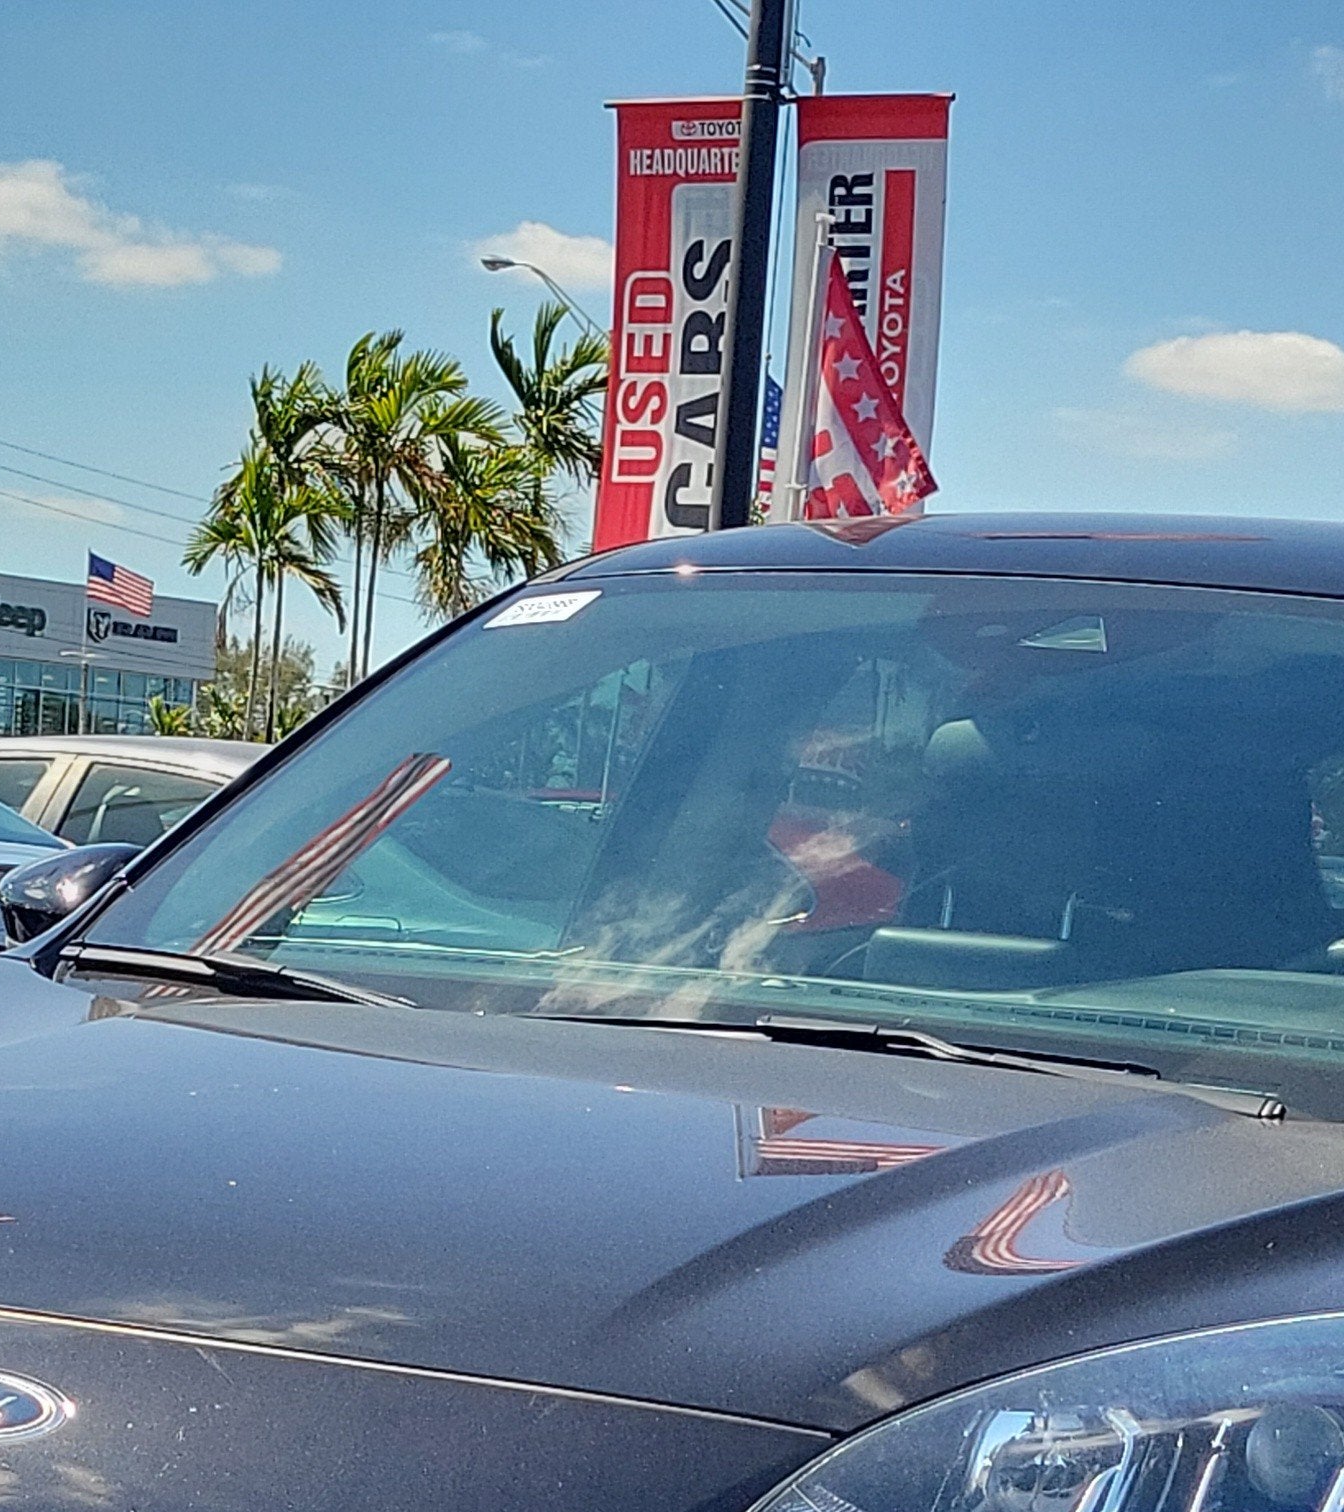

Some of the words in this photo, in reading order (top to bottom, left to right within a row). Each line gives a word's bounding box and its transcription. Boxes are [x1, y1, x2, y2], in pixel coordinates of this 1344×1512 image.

[630, 148, 740, 177] HEADQUARTE
[699, 121, 741, 136] TOYOT
[878, 268, 906, 400] OYOTA
[613, 273, 674, 482] USED
[664, 239, 733, 532] CARS
[113, 621, 178, 643] RAM
